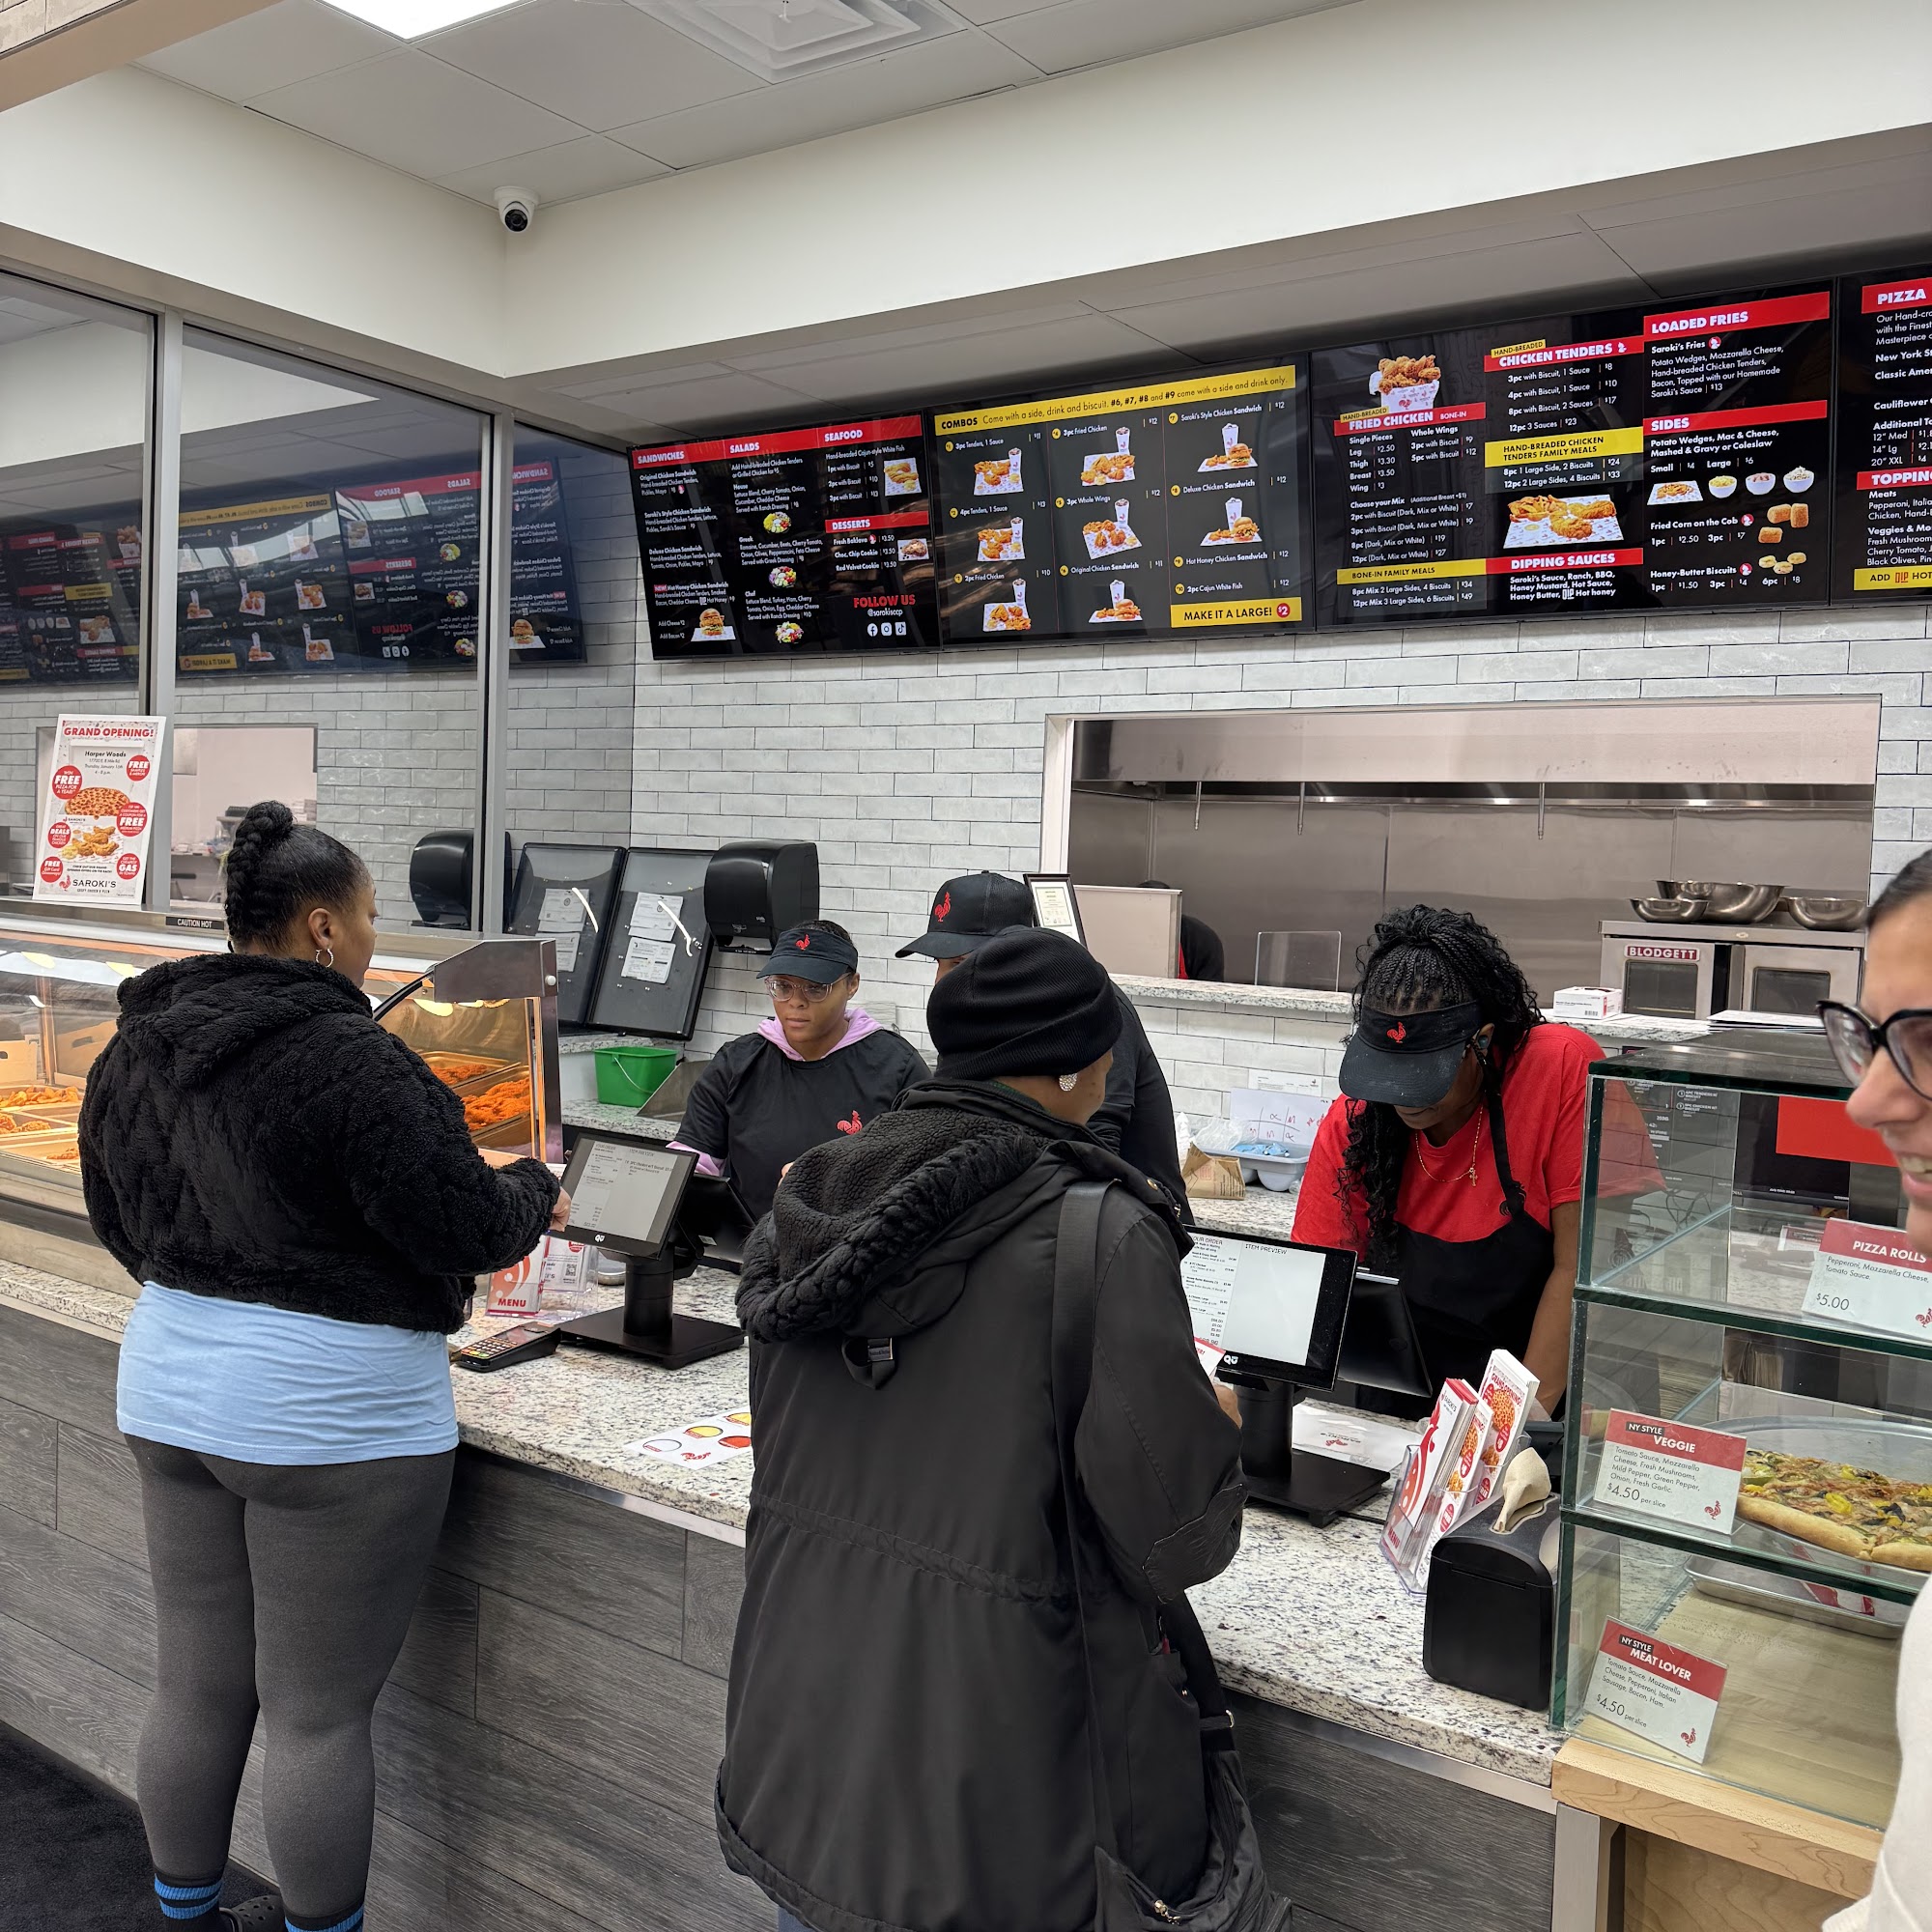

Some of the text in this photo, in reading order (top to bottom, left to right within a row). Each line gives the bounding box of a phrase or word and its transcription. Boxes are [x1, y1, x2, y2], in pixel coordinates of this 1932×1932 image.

[1878, 289, 1926, 304] PIZZA
[1652, 311, 1748, 333] LOADED FRIES
[1876, 333, 1926, 345] Masterpiece
[1494, 342, 1543, 355] HAND-BREADED
[1652, 340, 1705, 354] Saroki's Fries
[1499, 343, 1613, 367] CHICKEN TENDERS
[1652, 345, 1783, 367] Potato Wedges, Mozzarella Cheese,
[1876, 350, 1921, 362] New York
[1508, 374, 1522, 384] 3pc
[1538, 370, 1561, 379] Biscuit,
[1875, 370, 1906, 380] Classic
[941, 417, 978, 429] COMBOS
[983, 415, 1003, 424] Come
[1005, 412, 1020, 421] with
[1047, 406, 1065, 415] drink
[1067, 403, 1081, 413] and
[1083, 399, 1109, 410] biscuit.
[1111, 398, 1122, 407] #6,
[1151, 393, 1163, 402] and
[1197, 385, 1210, 395] with
[1219, 383, 1233, 391] side
[1251, 379, 1268, 387] drink
[1270, 377, 1287, 386] only.
[1874, 399, 1928, 410] Cauliflower
[1343, 408, 1386, 420] HAND-BREADED
[1350, 418, 1381, 431] FRIED
[1383, 412, 1433, 426] CHICKEN
[1651, 417, 1690, 431] SIDES
[1873, 417, 1922, 430] Additional
[825, 430, 863, 441] SEAFOOD
[1411, 426, 1458, 437] Whole Wings
[730, 442, 759, 453] SALADS
[1503, 437, 1604, 453] HAND-BREADED CHICKEN
[638, 451, 685, 464] SANDWICHES
[1504, 451, 1537, 461] TENDERS
[1540, 449, 1569, 458] FAMILY
[1868, 500, 1910, 510] Pepperoni,
[833, 520, 870, 529] DESSERTS
[1651, 522, 1671, 530] Fried
[1867, 526, 1904, 536] Veggies
[1511, 554, 1615, 569] DIPPING SAUCES
[1352, 570, 1382, 579] BONE-IN
[1651, 566, 1737, 579] Honey-Butter Biscuits
[854, 595, 916, 608] FOLLOW US
[1184, 611, 1212, 620] MAKE
[1236, 608, 1272, 617] LARGE!
[1278, 606, 1288, 615] $2
[64, 727, 154, 737] GRAND OPENING!
[54, 776, 79, 784] FREE
[119, 817, 144, 826] FREE
[72, 879, 116, 888] SAROKI'S
[178, 919, 200, 927] CAUTION
[1630, 947, 1695, 959] BLODGETT
[1260, 1245, 1287, 1254] PREVIEW
[1853, 1240, 1926, 1264] PIZZA ROLLS
[1826, 1265, 1870, 1281] Tomato Sauce.
[1828, 1256, 1929, 1283] Pepperoni, Mozzarella Cheese,
[497, 1298, 526, 1307] MENU
[1816, 1293, 1849, 1310] $5.00
[1642, 1426, 1662, 1435] STYLE
[1653, 1435, 1696, 1453] VEGGIE
[1615, 1446, 1700, 1471] Tomato Sauce, Mozzarella
[1614, 1456, 1696, 1481] Cheese, Fresh Mushrooms,
[1610, 1473, 1672, 1493] Onion, Fresh Garlic.
[1612, 1464, 1700, 1492] Mild Pepper, Green Pepper,
[1607, 1483, 1640, 1501] $4.50
[1653, 1499, 1665, 1508] slice
[1621, 1636, 1652, 1652] NY STYLE
[1630, 1648, 1691, 1681] MEAT LOVER
[1606, 1658, 1681, 1695] Tomato Sauce, Mozzarella
[1605, 1667, 1677, 1703] Cheese, Pepperoni, Italian
[1603, 1676, 1664, 1708] Sausage, Bacon, Ham.
[1597, 1693, 1647, 1727] $4.50 per slice
